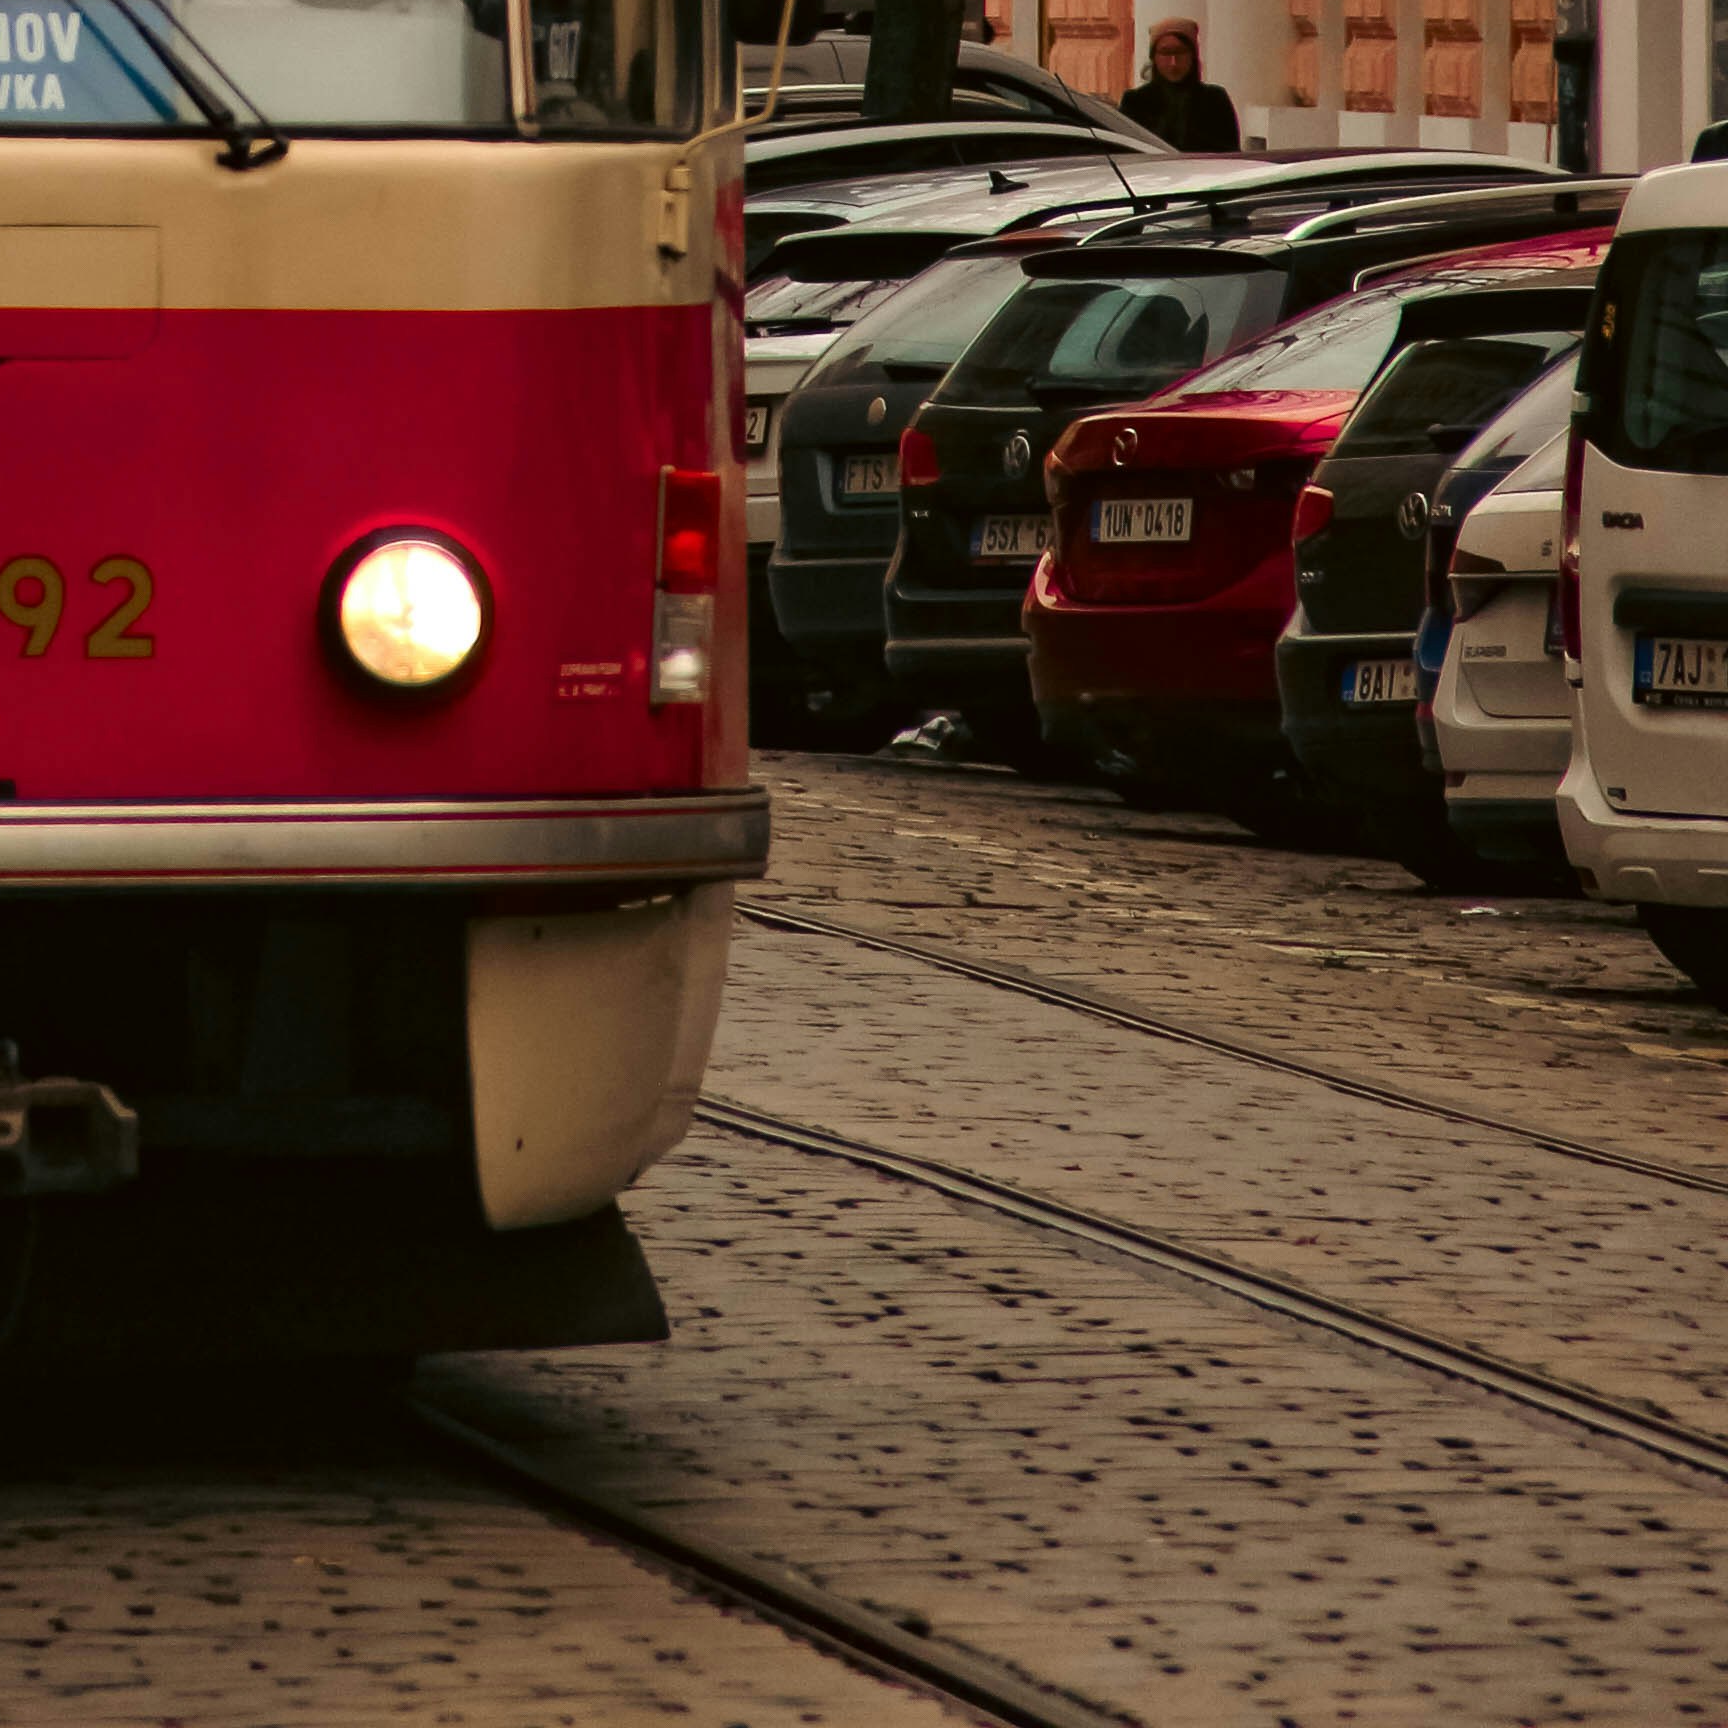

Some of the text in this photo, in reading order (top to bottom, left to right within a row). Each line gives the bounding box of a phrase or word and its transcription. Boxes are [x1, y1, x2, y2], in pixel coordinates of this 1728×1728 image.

[1105, 503, 1185, 537] 1UN 0418
[1658, 643, 1703, 685] 7AJ
